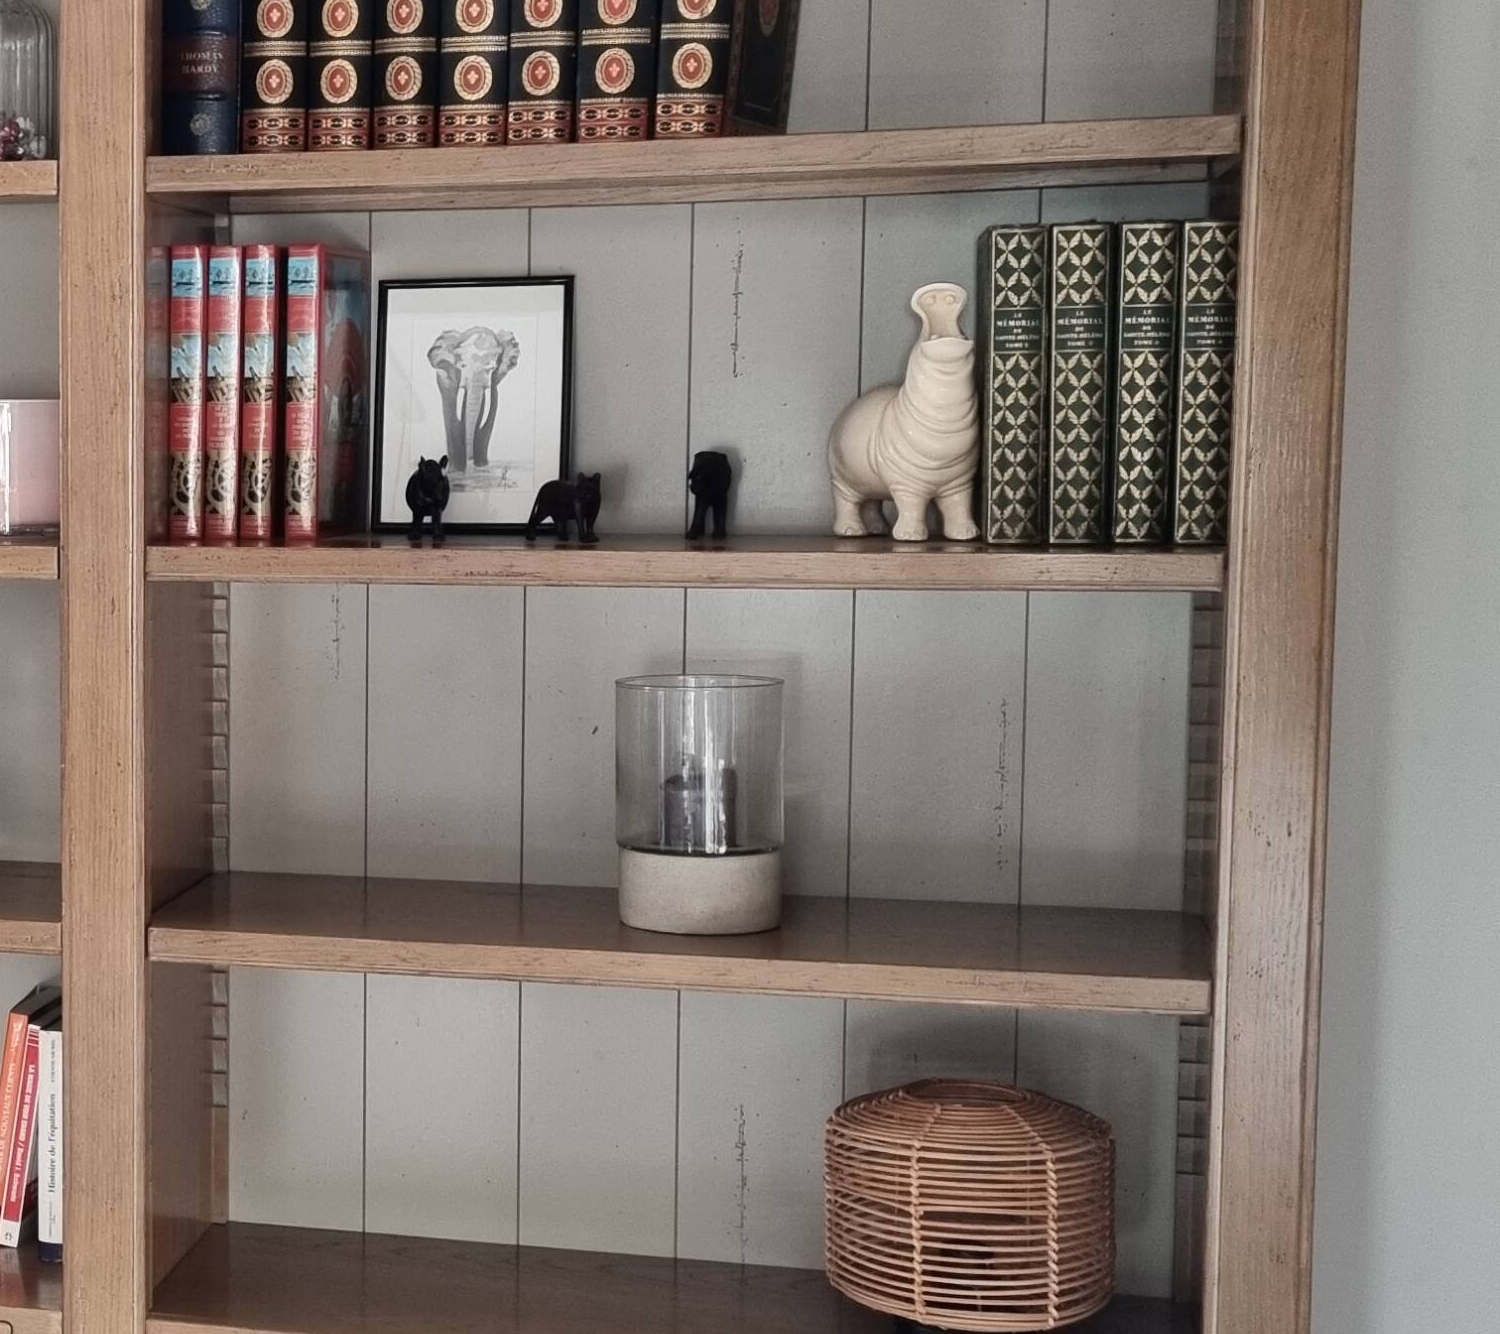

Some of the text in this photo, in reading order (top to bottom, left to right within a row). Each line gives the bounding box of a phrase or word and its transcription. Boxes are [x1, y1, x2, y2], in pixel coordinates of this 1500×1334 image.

[181, 65, 220, 74] HARDY
[996, 319, 1040, 327] MÉMORIAL
[1057, 317, 1103, 325] MÉMORIAL
[1125, 316, 1169, 324] MÉMORIAL
[45, 1093, 58, 1142] l'équitation
[46, 1145, 56, 1157] de
[46, 1159, 56, 1194] Histoire
